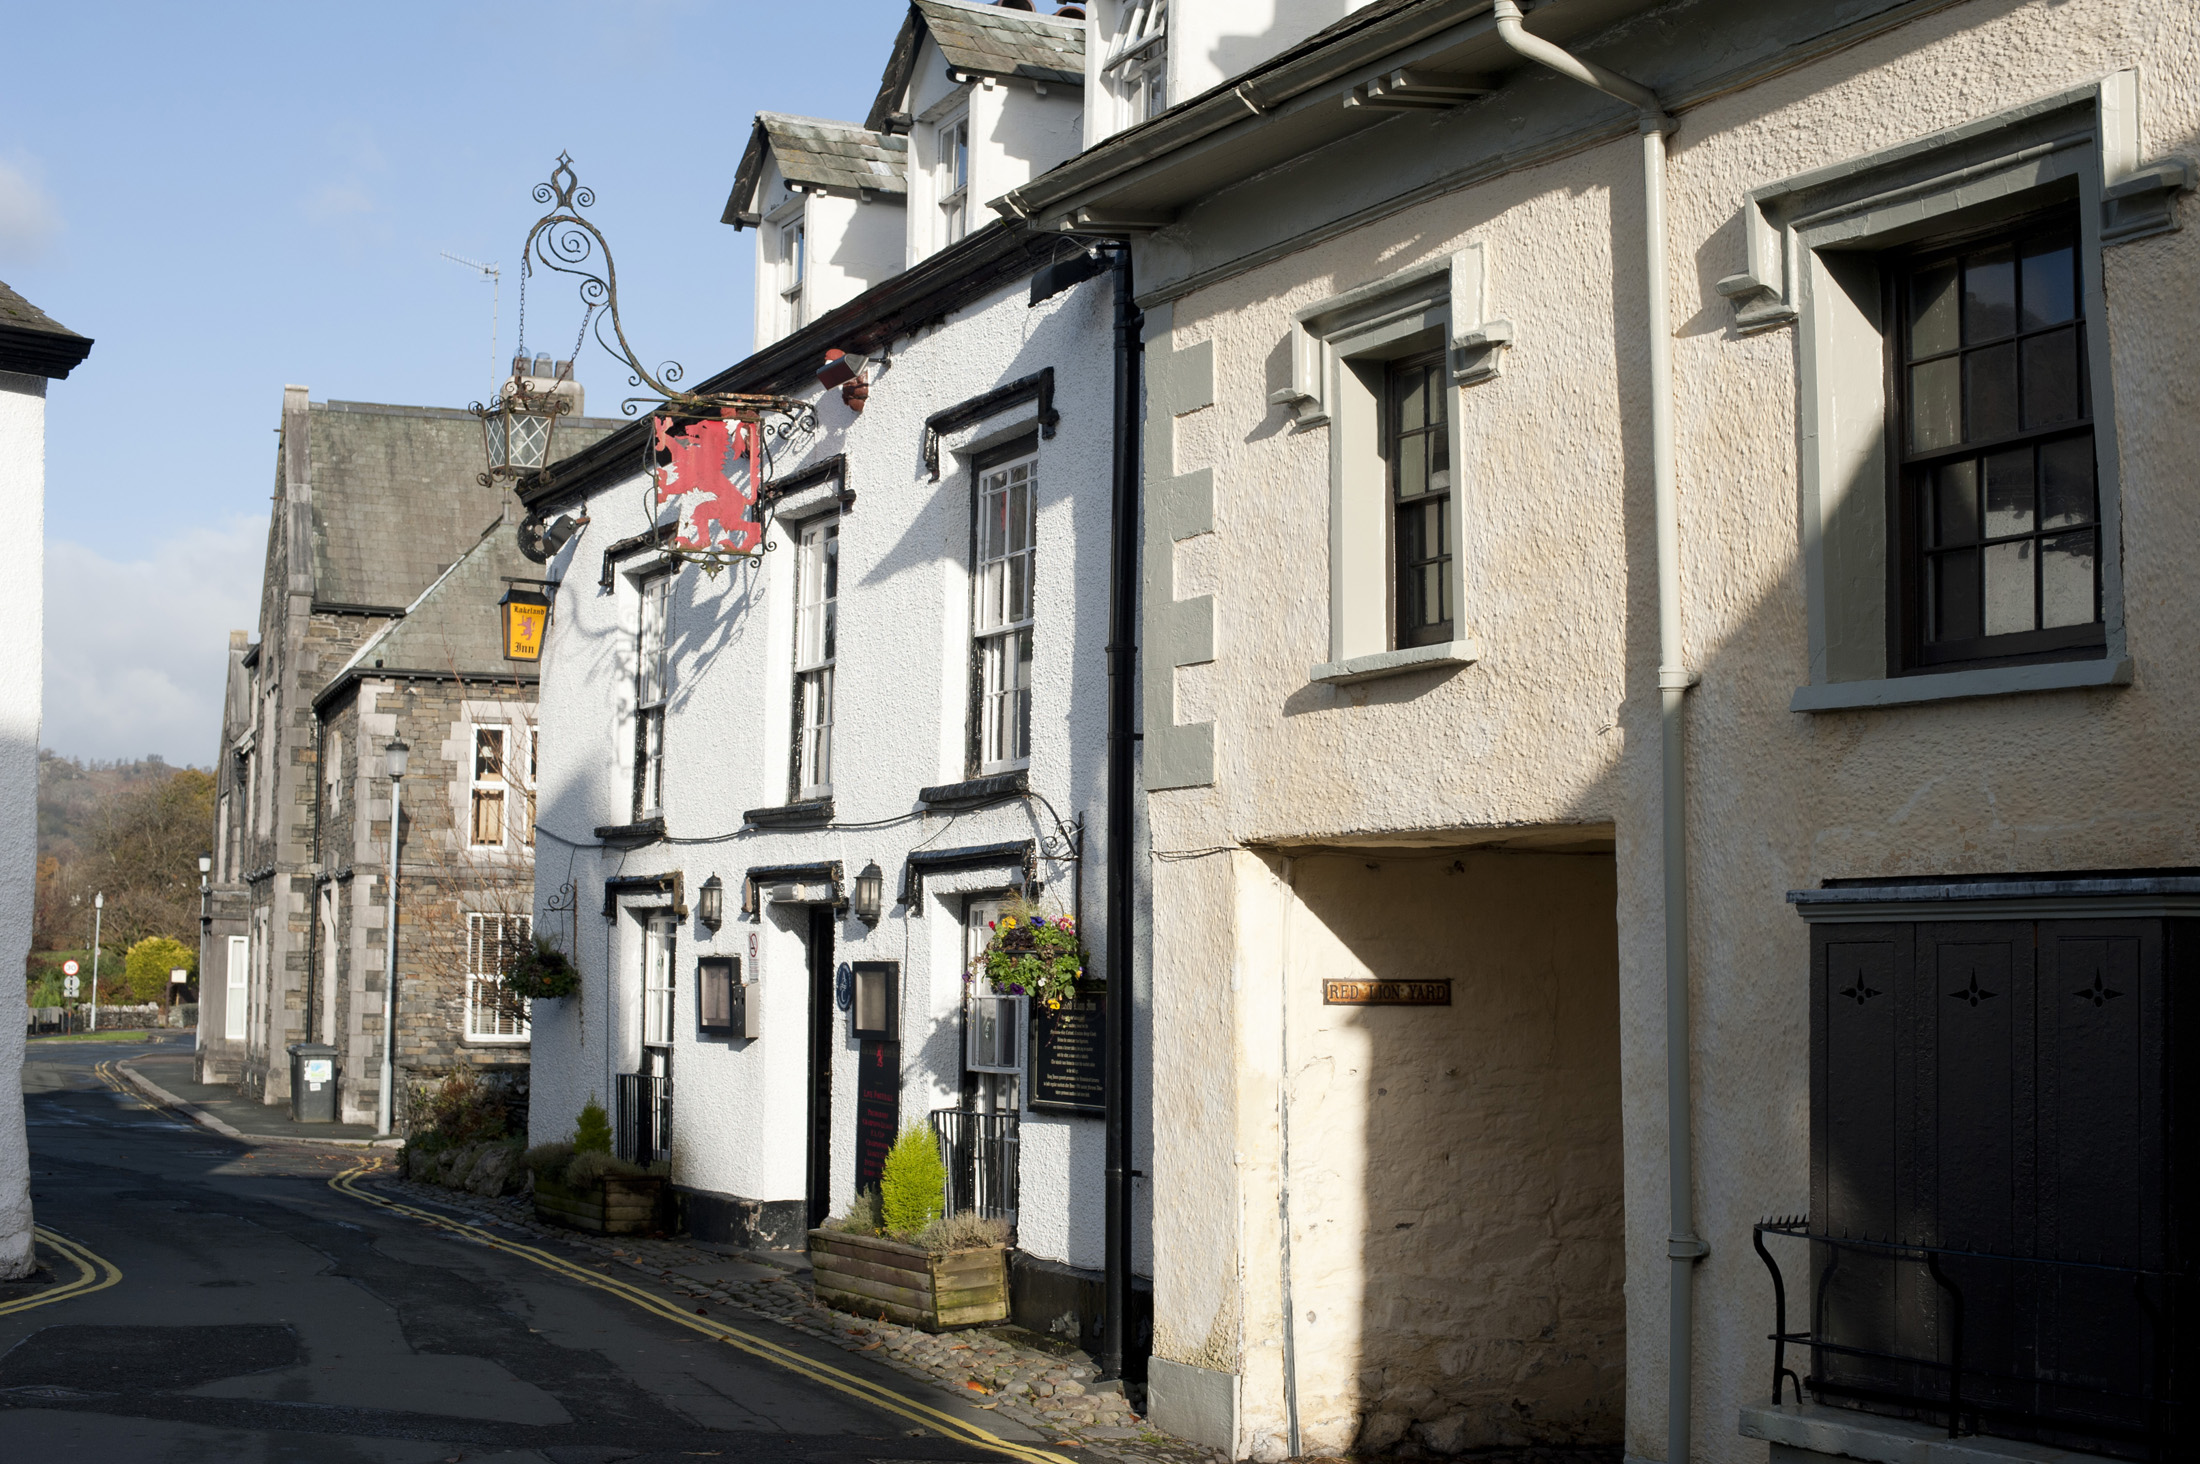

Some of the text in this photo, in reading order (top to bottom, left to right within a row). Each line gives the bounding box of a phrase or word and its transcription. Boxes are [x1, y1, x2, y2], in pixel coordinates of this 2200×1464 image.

[513, 605, 545, 616] Lakeland
[514, 641, 535, 654] Inn
[1329, 984, 1446, 1000] RED LION YARD
